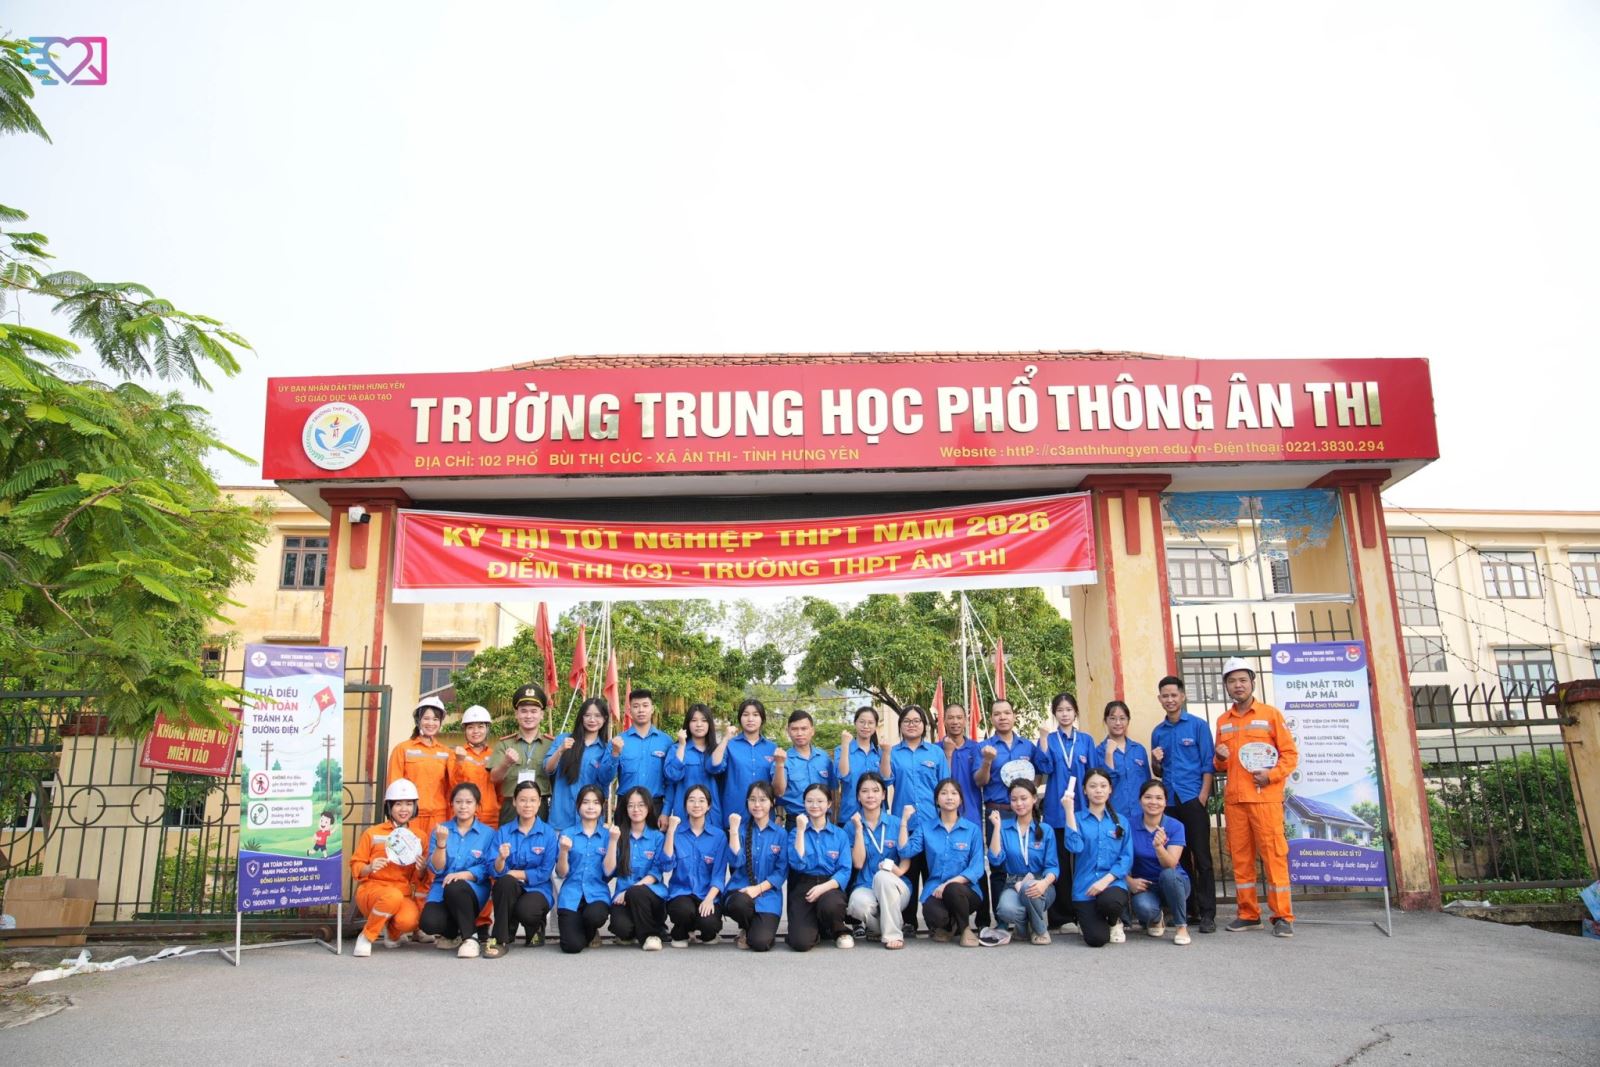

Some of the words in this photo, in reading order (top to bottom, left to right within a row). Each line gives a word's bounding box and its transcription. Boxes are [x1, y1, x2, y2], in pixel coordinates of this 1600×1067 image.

[410, 382, 620, 443] TRƯỜNG
[634, 389, 804, 438] TRUNG
[820, 388, 924, 444] HỌC
[937, 364, 1039, 432] PHỔ
[1048, 372, 1214, 430] THÔNG
[1226, 372, 1295, 429] ÂN
[1304, 381, 1382, 427] THI
[940, 446, 996, 457] Website
[1286, 440, 1384, 452] 0221.3830.294
[415, 456, 441, 470] ĐỊA
[445, 451, 474, 467] CHỈ:
[479, 456, 502, 466] 102
[506, 449, 538, 466] PHỐ
[550, 450, 574, 466] BÙI
[579, 454, 603, 467] THỊ
[610, 449, 642, 464] CÚC
[656, 449, 676, 463] XÃ
[682, 448, 703, 463] ÂN
[743, 446, 776, 461] TỈNH
[782, 449, 826, 461] HƯNG
[829, 446, 859, 460] YÊN
[443, 524, 486, 547] KỲ
[497, 528, 550, 549] THI
[633, 530, 764, 552] NGHIỆP
[776, 526, 862, 546] THPT
[966, 512, 1050, 536] 2026
[488, 552, 559, 579] ĐIỂM
[567, 562, 613, 578] THI
[622, 563, 672, 580] (03)
[698, 557, 819, 580] TRƯỜNG
[828, 556, 901, 575] THPT
[911, 549, 952, 570] ÂN
[960, 548, 1006, 566] THI
[1286, 680, 1308, 691] ĐIỆN
[1310, 680, 1329, 690] MẶT
[1331, 678, 1354, 688] TRỜI
[1320, 690, 1338, 698] MÁI
[253, 713, 280, 722] TRÁNH
[252, 724, 280, 734] ĐƯỜNG
[282, 725, 299, 736] ĐIỆN
